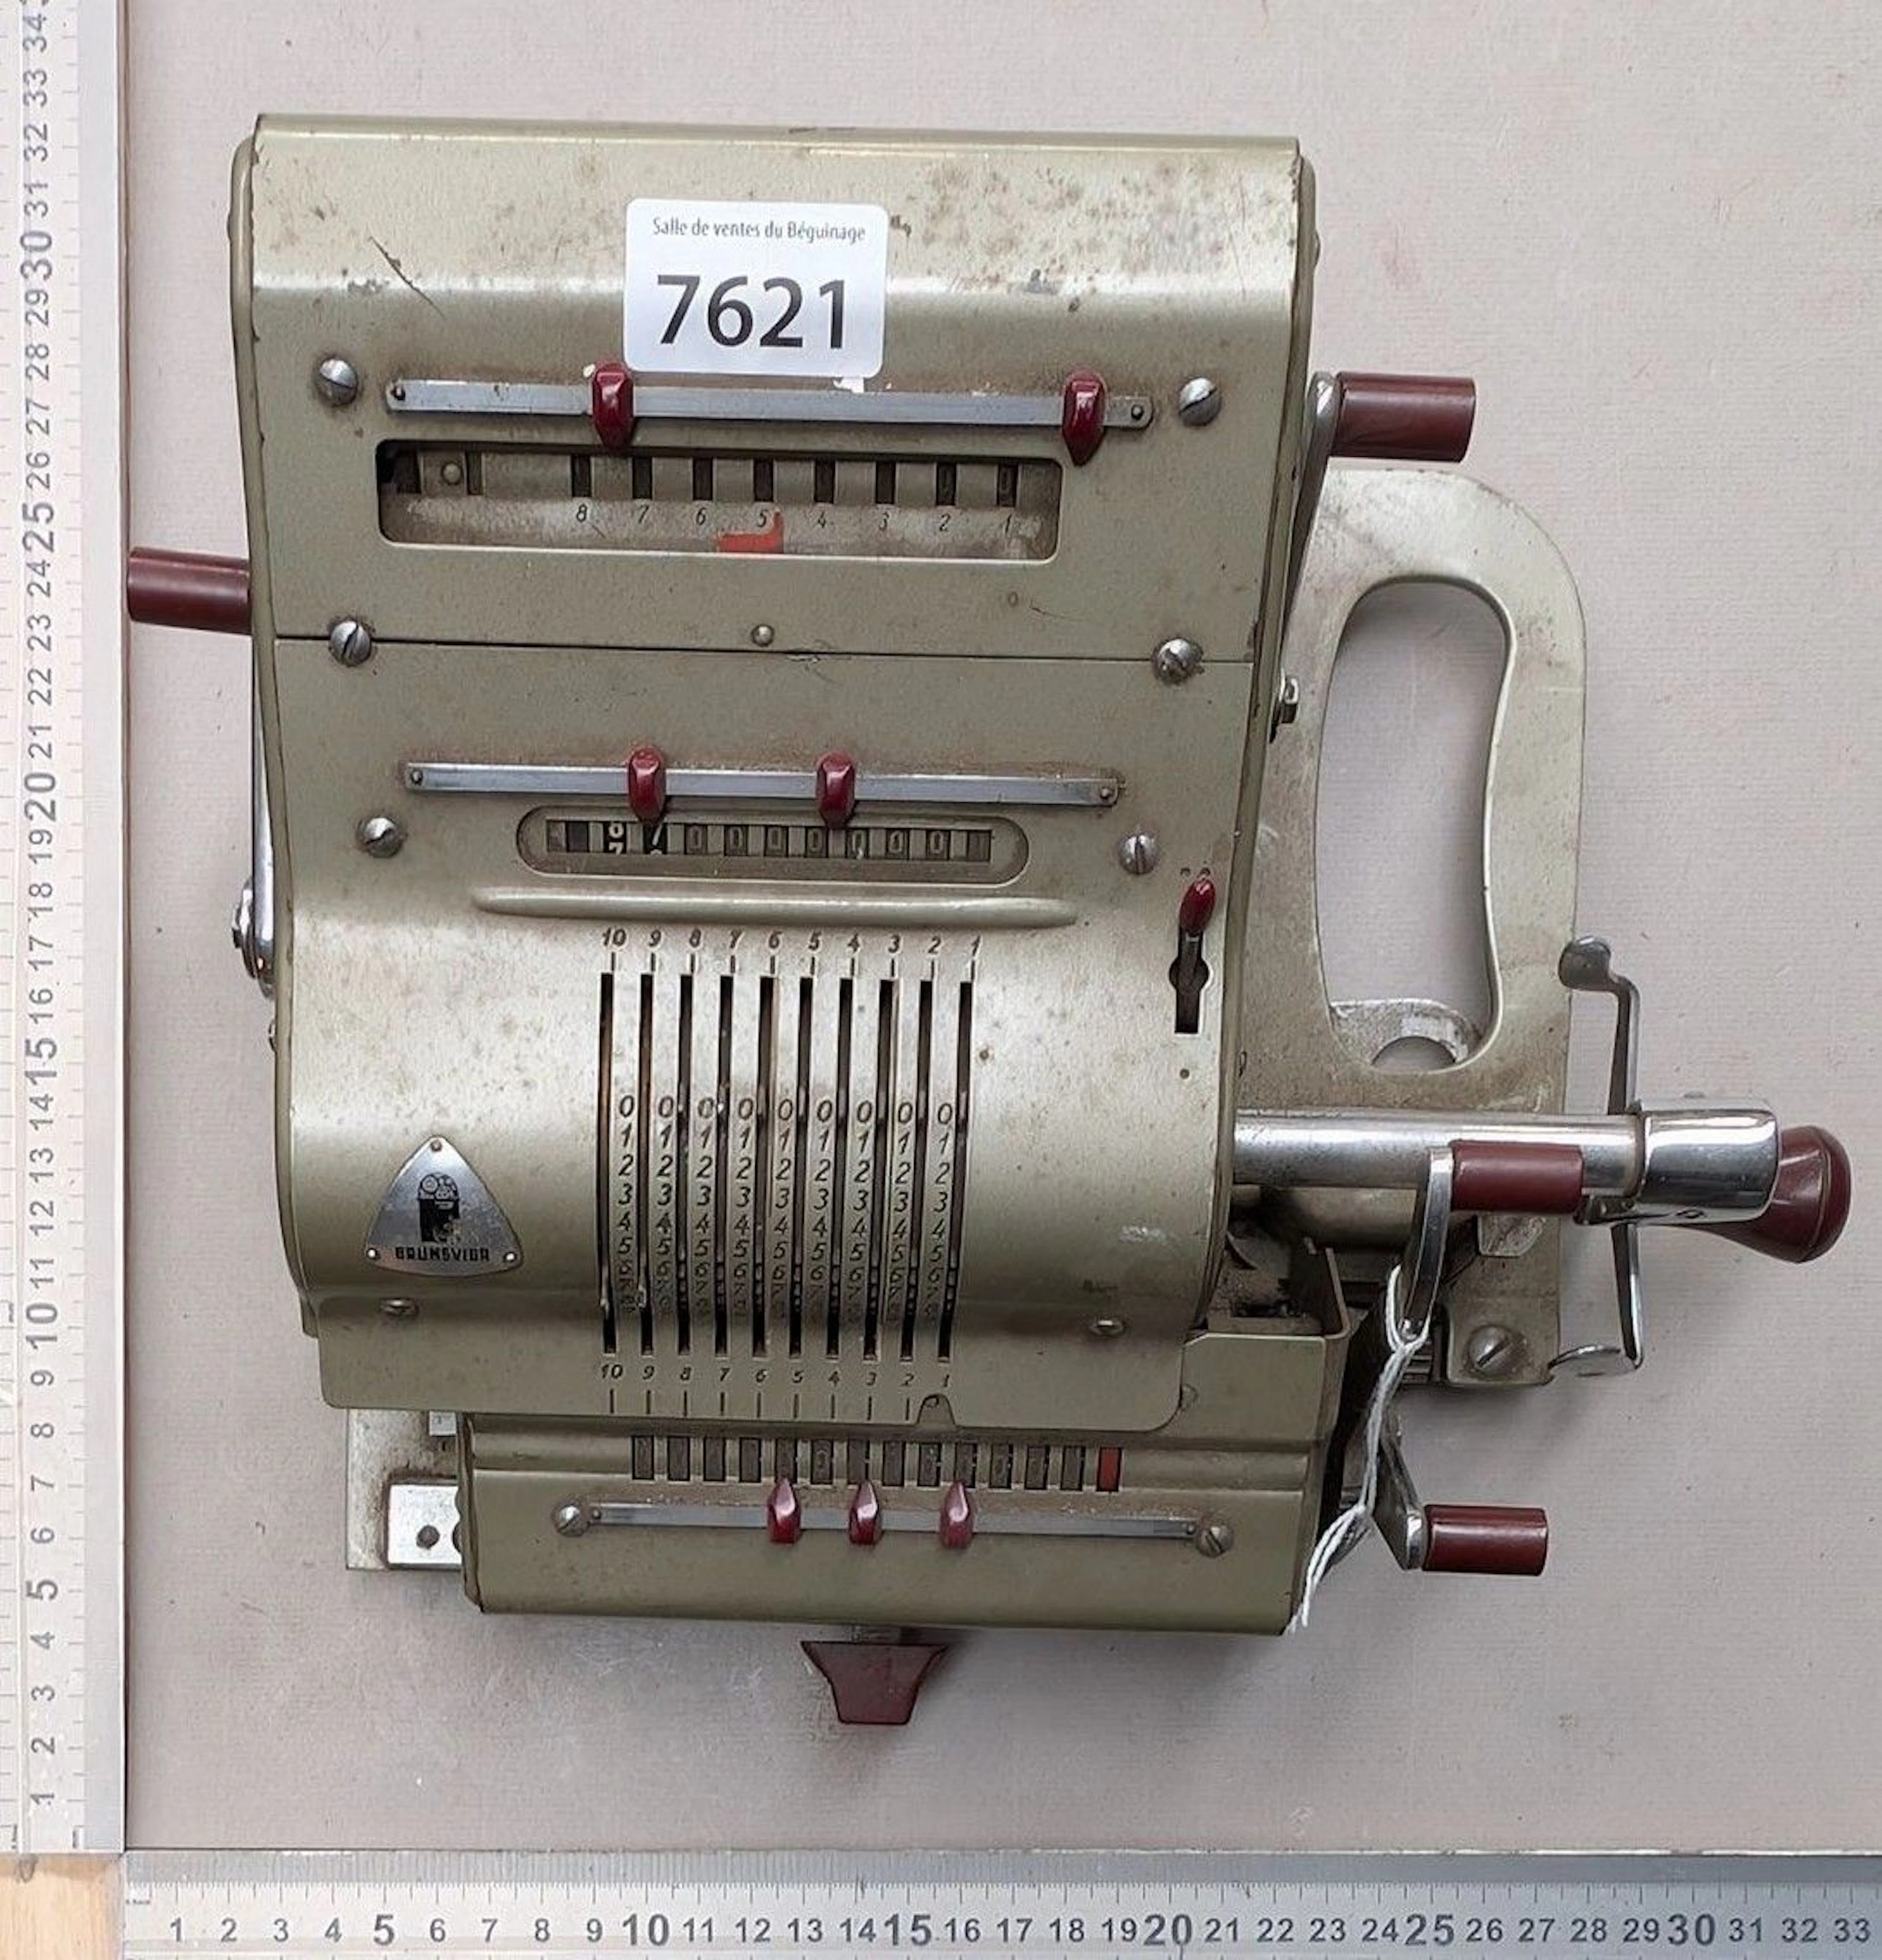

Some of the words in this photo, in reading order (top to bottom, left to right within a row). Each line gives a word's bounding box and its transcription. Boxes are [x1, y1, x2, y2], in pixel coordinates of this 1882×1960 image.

[22, 13, 47, 53] 34
[23, 69, 48, 108] 33
[23, 123, 48, 162] 32
[24, 181, 49, 218] 31
[653, 217, 688, 236] Salle
[691, 217, 710, 237] de
[713, 222, 761, 238] ventes
[765, 220, 783, 239] du
[787, 221, 866, 246] Béguinage
[21, 230, 52, 281] 30
[25, 289, 49, 327] 29
[658, 274, 844, 349] 7621
[25, 343, 50, 382] 28
[25, 397, 50, 436] 27
[25, 452, 50, 491] 26
[22, 502, 54, 553] 25
[575, 504, 588, 522] 8
[638, 505, 650, 523] 7
[696, 507, 706, 525] 6
[756, 509, 767, 527] 5
[817, 512, 826, 529] 4
[879, 513, 890, 531] 3
[939, 513, 951, 532] 2
[1005, 514, 1012, 534] 1
[25, 559, 51, 598] 24
[26, 614, 51, 651] 23
[27, 668, 51, 706] 22
[27, 725, 52, 759] 21
[24, 772, 56, 822] 20
[27, 829, 52, 865] 19
[27, 883, 53, 918] 18
[27, 935, 53, 971] 17
[602, 928, 627, 946] 10
[647, 929, 661, 948] 9
[689, 929, 701, 948] 8
[729, 931, 742, 949] 7
[768, 933, 780, 949] 6
[808, 933, 820, 951] 5
[847, 934, 860, 953] 4
[888, 936, 900, 953] 3
[927, 937, 941, 955] 2
[971, 936, 980, 957] 1
[28, 989, 53, 1024] 16
[24, 1038, 57, 1086] 15
[29, 1093, 53, 1131] 14
[619, 1095, 634, 1117] 0
[658, 1096, 673, 1117] 0
[698, 1097, 714, 1118] 0
[738, 1098, 753, 1120] 0
[779, 1099, 793, 1121] 0
[817, 1100, 832, 1122] 0
[857, 1100, 872, 1123] 0
[898, 1102, 913, 1124] 0
[938, 1103, 952, 1124] 0
[621, 1123, 632, 1147] 1
[660, 1125, 671, 1148] 1
[700, 1126, 712, 1148] 1
[741, 1127, 751, 1149] 1
[780, 1128, 791, 1151] 1
[819, 1129, 830, 1151] 1
[858, 1130, 869, 1153] 1
[898, 1132, 911, 1155] 1
[939, 1133, 948, 1155] 1
[29, 1148, 54, 1183] 13
[619, 1154, 633, 1176] 2
[657, 1155, 673, 1177] 2
[697, 1156, 712, 1178] 2
[736, 1157, 751, 1180] 2
[776, 1159, 791, 1181] 2
[816, 1159, 831, 1181] 2
[854, 1161, 870, 1183] 2
[895, 1163, 911, 1183] 2
[935, 1163, 950, 1185] 2
[619, 1183, 632, 1205] 3
[658, 1183, 672, 1206] 3
[697, 1186, 711, 1207] 3
[737, 1187, 751, 1208] 3
[776, 1188, 790, 1209] 3
[814, 1189, 829, 1210] 3
[853, 1190, 869, 1211] 3
[894, 1192, 908, 1212] 3
[934, 1192, 948, 1213] 3
[29, 1201, 54, 1236] 12
[618, 1212, 631, 1232] 4
[696, 1214, 711, 1235] 4
[735, 1215, 749, 1236] 4
[774, 1216, 788, 1236] 4
[813, 1216, 827, 1238] 4
[852, 1218, 866, 1239] 4
[893, 1219, 906, 1240] 4
[932, 1219, 945, 1241] 4
[734, 1241, 749, 1257] 5
[773, 1241, 788, 1259] 5
[812, 1243, 826, 1261] 5
[29, 1259, 54, 1289] 11
[25, 1303, 58, 1350] 10
[30, 1370, 54, 1387] 9
[602, 1364, 623, 1379] 10
[643, 1365, 655, 1380] 9
[680, 1366, 692, 1381] 8
[719, 1367, 731, 1382] 7
[755, 1368, 768, 1383] 6
[792, 1369, 804, 1384] 5
[828, 1371, 840, 1387] 4
[866, 1371, 878, 1386] 3
[901, 1373, 915, 1387] 2
[942, 1374, 951, 1388] 1
[30, 1423, 54, 1439] 8
[30, 1475, 54, 1492] 7
[30, 1527, 55, 1544] 6
[25, 1579, 58, 1601] 5
[30, 1632, 55, 1650] 4
[30, 1685, 55, 1702] 3
[30, 1737, 55, 1755] 2
[29, 1793, 55, 1805] 1
[170, 1918, 182, 1942] 1
[221, 1918, 237, 1942] 2
[273, 1919, 289, 1942] 3
[325, 1918, 342, 1942] 4
[374, 1914, 395, 1946] 5
[430, 1919, 446, 1942] 6
[482, 1919, 497, 1942] 7
[535, 1919, 550, 1942] 8
[587, 1918, 603, 1942] 9
[623, 1914, 669, 1946] 10
[683, 1917, 713, 1943] 11
[735, 1917, 771, 1943] 12
[788, 1918, 823, 1943] 13
[840, 1917, 876, 1943] 14
[884, 1913, 932, 1947] 15
[944, 1917, 981, 1943] 16
[996, 1917, 1033, 1943] 17
[1049, 1917, 1085, 1943] 18
[1102, 1917, 1137, 1943] 19
[1143, 1913, 1192, 1947] 20
[1205, 1917, 1238, 1942] 21
[1257, 1918, 1294, 1942] 22
[1309, 1918, 1346, 1942] 23
[1362, 1918, 1399, 1942] 24
[1405, 1914, 1454, 1946] 25
[1466, 1918, 1503, 1942] 26
[1518, 1918, 1555, 1942] 27
[1570, 1918, 1607, 1942] 28
[1623, 1918, 1659, 1942] 29
[1668, 1914, 1715, 1946] 30
[1729, 1918, 1761, 1942] 31
[1782, 1918, 1817, 1942] 32
[1834, 1918, 1870, 1942] 33
